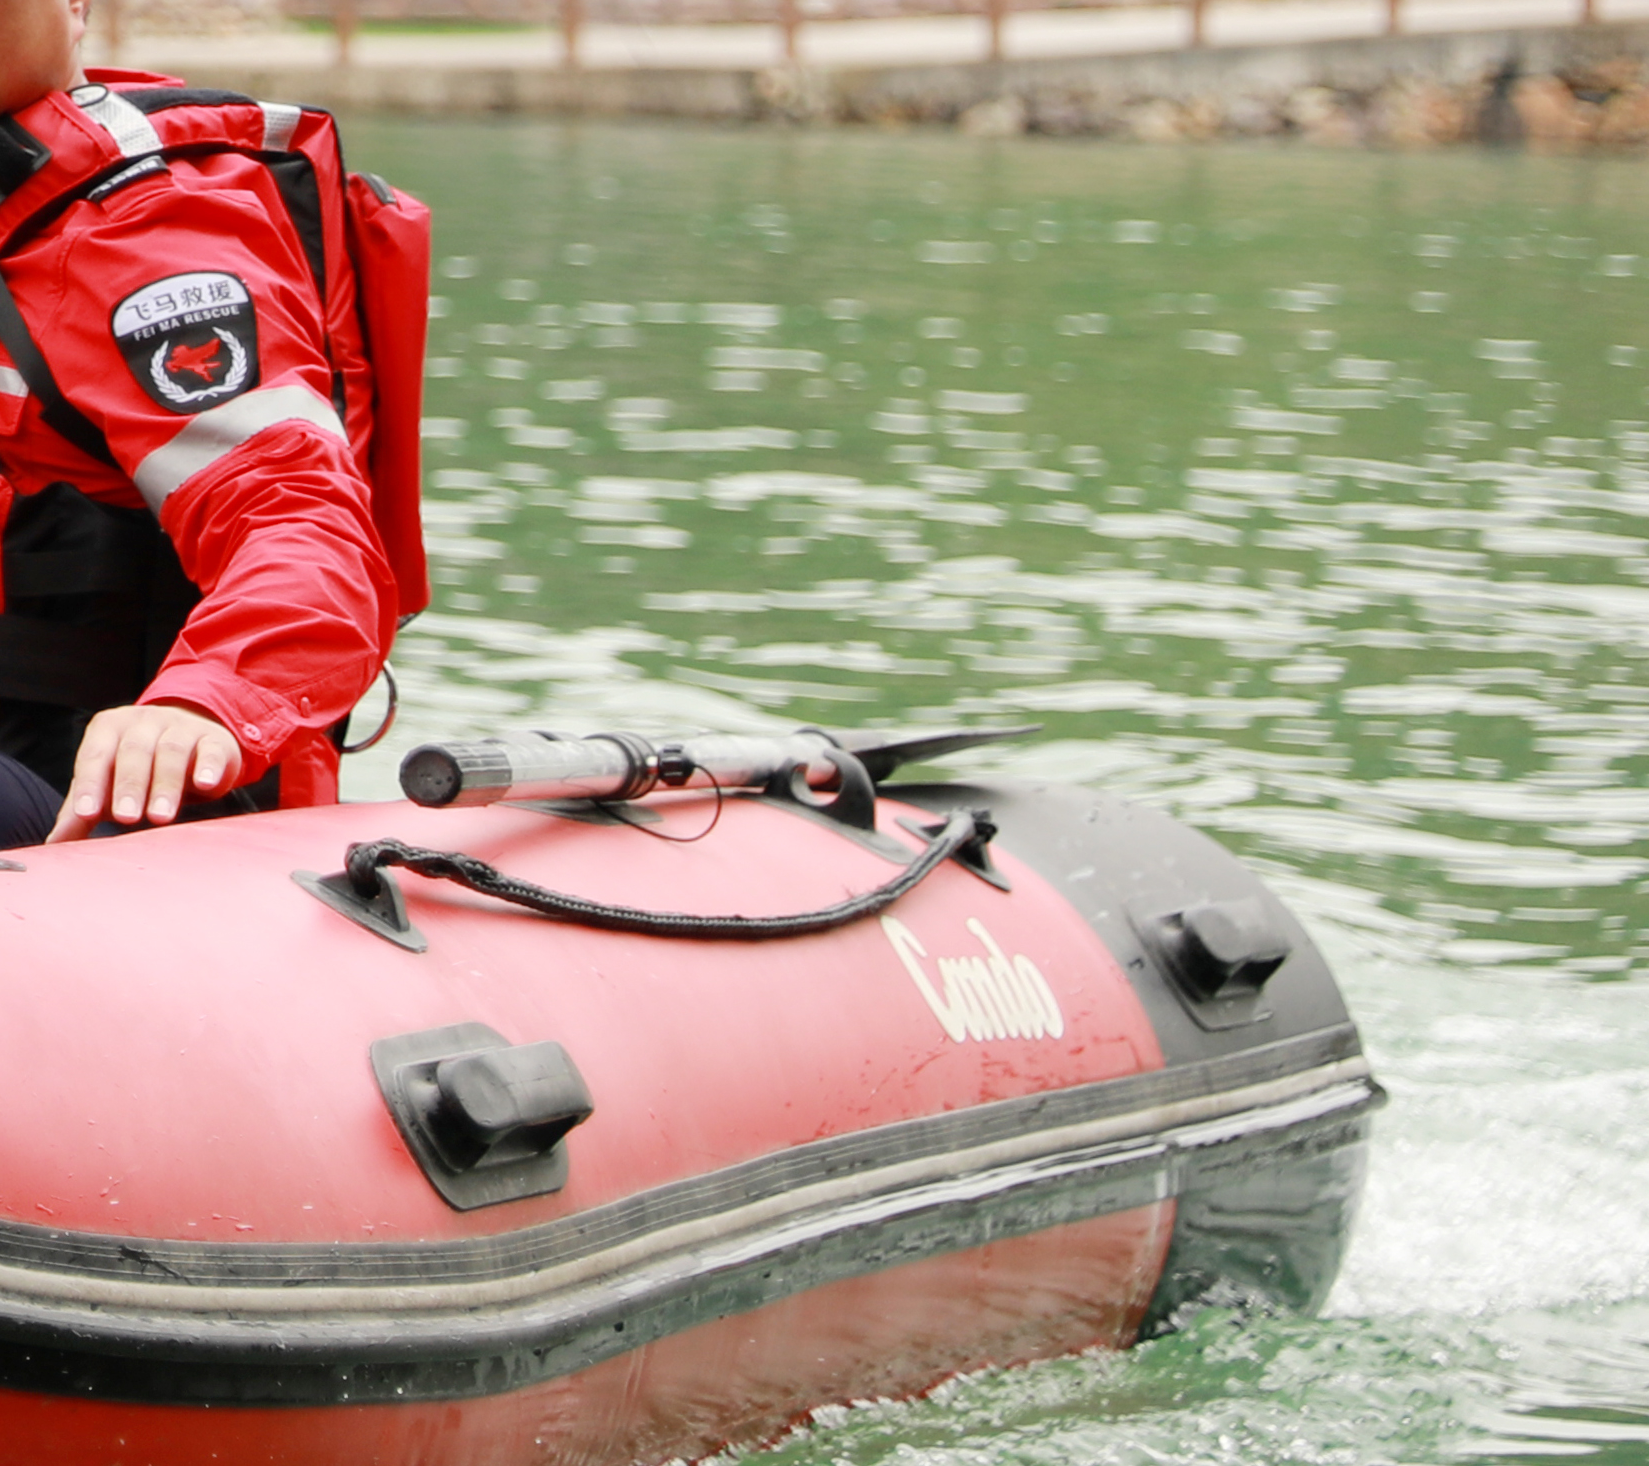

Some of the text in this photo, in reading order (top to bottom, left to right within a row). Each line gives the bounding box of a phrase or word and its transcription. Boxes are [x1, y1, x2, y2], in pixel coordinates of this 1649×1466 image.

[125, 279, 234, 321] 飞马救援
[133, 305, 241, 342] FEI MA RESCUE
